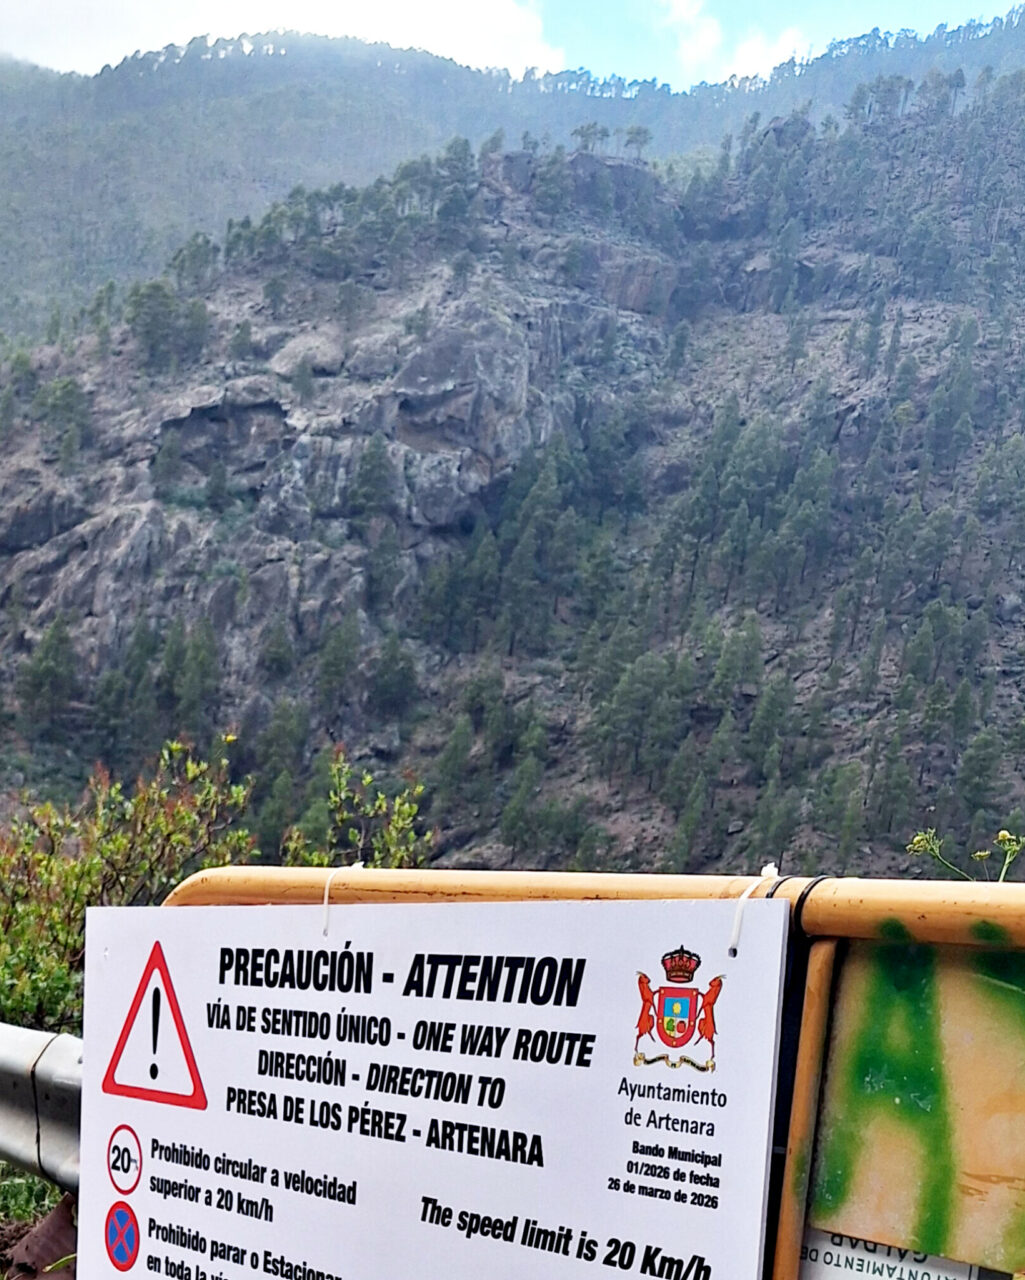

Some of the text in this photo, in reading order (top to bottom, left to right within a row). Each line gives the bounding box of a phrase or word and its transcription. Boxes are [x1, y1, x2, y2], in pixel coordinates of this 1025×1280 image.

[219, 941, 373, 993] PRECAUCIÓN
[402, 954, 586, 1006] ATTENTION
[206, 997, 230, 1029] VÍA
[236, 1005, 256, 1031] DE
[261, 1007, 330, 1039] SENTIDO
[336, 1007, 390, 1046] ÚNICO
[413, 1020, 456, 1052] ONE
[460, 1024, 510, 1057] WAY
[512, 1029, 596, 1067] ROUTE
[258, 1049, 346, 1086] DIRECCIÓN
[366, 1063, 472, 1104] DIRECTION
[477, 1076, 505, 1108] TO
[618, 1077, 726, 1107] Ayuntamiento
[226, 1086, 277, 1119] PRESA
[283, 1095, 304, 1123] DE
[309, 1099, 341, 1130] LOS
[347, 1101, 406, 1142] PÉREZ
[426, 1118, 543, 1167] ARTENARA
[624, 1107, 714, 1136] de Artenara
[111, 1144, 131, 1174] 20
[151, 1138, 356, 1204] Prohibido circular a velocidad
[627, 1160, 719, 1187] 01/2026 de fecha
[632, 1141, 721, 1167] Bando Municipal
[150, 1176, 272, 1222] superior a 20 km/h
[608, 1177, 718, 1208] 26 de marzo de 2026
[148, 1218, 206, 1253] Prohibido
[210, 1240, 246, 1265] parar
[250, 1252, 258, 1269] o
[421, 1196, 452, 1226] The
[457, 1211, 518, 1242] speed
[521, 1219, 572, 1255] limit
[576, 1231, 597, 1261] is
[602, 1238, 635, 1269] 20
[147, 1255, 160, 1272] en
